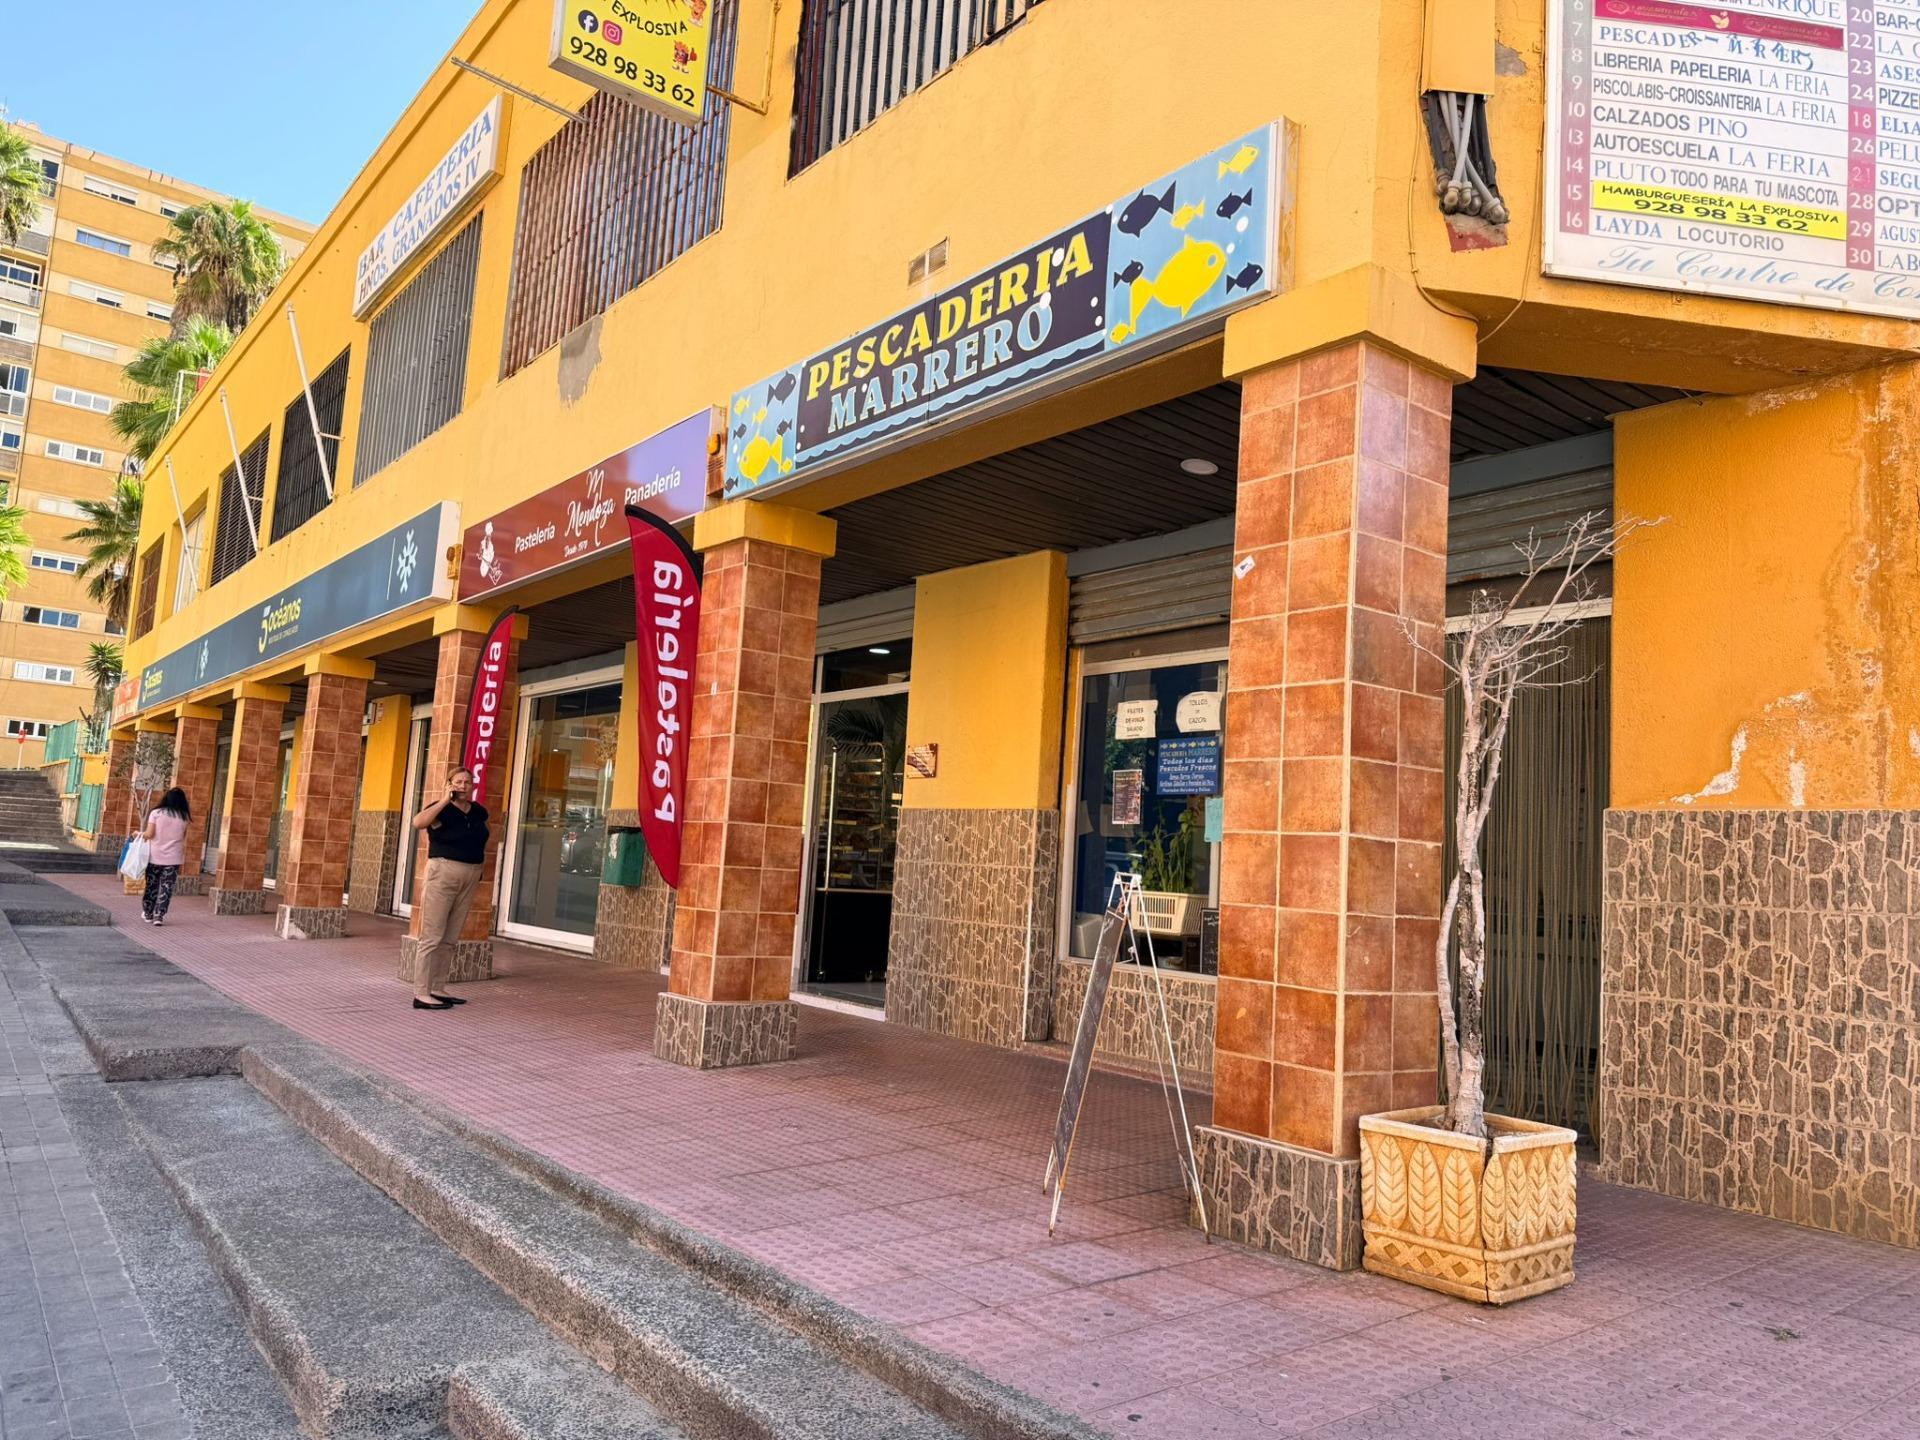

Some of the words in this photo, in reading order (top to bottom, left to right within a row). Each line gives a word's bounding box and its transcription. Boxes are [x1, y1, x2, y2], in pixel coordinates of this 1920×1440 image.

[611, 0, 688, 36] EXPLOSIVA
[1572, 22, 1582, 35] 7
[1850, 7, 1872, 24] 20
[1849, 32, 1873, 50] 22
[1572, 49, 1582, 62] 8
[1850, 58, 1872, 75] 23
[570, 36, 607, 67] 928
[614, 55, 638, 81] 98
[643, 69, 666, 93] 33
[671, 83, 695, 108] 62
[1572, 75, 1582, 90] 9
[1594, 51, 1663, 73] LIBRERIA
[1671, 60, 1752, 84] PAPELERIA
[1760, 69, 1779, 89] LA
[1785, 73, 1829, 96] FERIA
[1851, 84, 1874, 101] 24
[1879, 87, 1920, 110] PIZZE
[1568, 101, 1585, 118] 10
[1593, 105, 1690, 131] CALZADOS
[1698, 116, 1748, 138] PINO
[1766, 97, 1785, 117] LA
[1792, 101, 1836, 124] FERIA
[1853, 111, 1872, 129] 18
[1568, 128, 1584, 145] 13
[1851, 137, 1874, 154] 26
[1566, 157, 1584, 173] 14
[1593, 133, 1719, 162] AUTOESCUELA
[1729, 147, 1756, 168] LA
[1767, 152, 1830, 178] FERIA
[359, 233, 386, 281] BAR
[393, 111, 492, 238] CAFETERIA
[1567, 184, 1582, 200] 15
[1595, 159, 1666, 184] PLUTO
[1671, 169, 1708, 189] TODO
[1713, 174, 1748, 194] PARA
[1755, 180, 1772, 197] TU
[1777, 183, 1839, 206] MASCOTA
[392, 174, 461, 265] GRANADOS
[465, 151, 481, 189] IV
[1602, 185, 1734, 208] HAMBURGUESERÍA
[1740, 202, 1757, 212] LA
[1763, 205, 1839, 223] EXPLOSIVA
[1850, 192, 1874, 210] 28
[1566, 211, 1583, 228] 16
[1634, 199, 1685, 214] 928
[1694, 206, 1727, 220] 98
[1736, 212, 1767, 226] 33
[1776, 218, 1809, 232] 62
[1850, 220, 1872, 238] 29
[1596, 215, 1662, 238] LAYDA
[1677, 225, 1784, 252] LOCUTORIO
[1598, 245, 1655, 272] Tu
[1676, 250, 1799, 284] Centro
[1814, 272, 1855, 293] de
[1849, 247, 1872, 265] 30
[806, 230, 1094, 402] PESCADERIA
[827, 302, 1054, 434] MARRERO
[624, 466, 681, 506] Panadería
[564, 492, 616, 537] Mendoza
[515, 521, 556, 553] Pastelería
[472, 641, 502, 801] nadería
